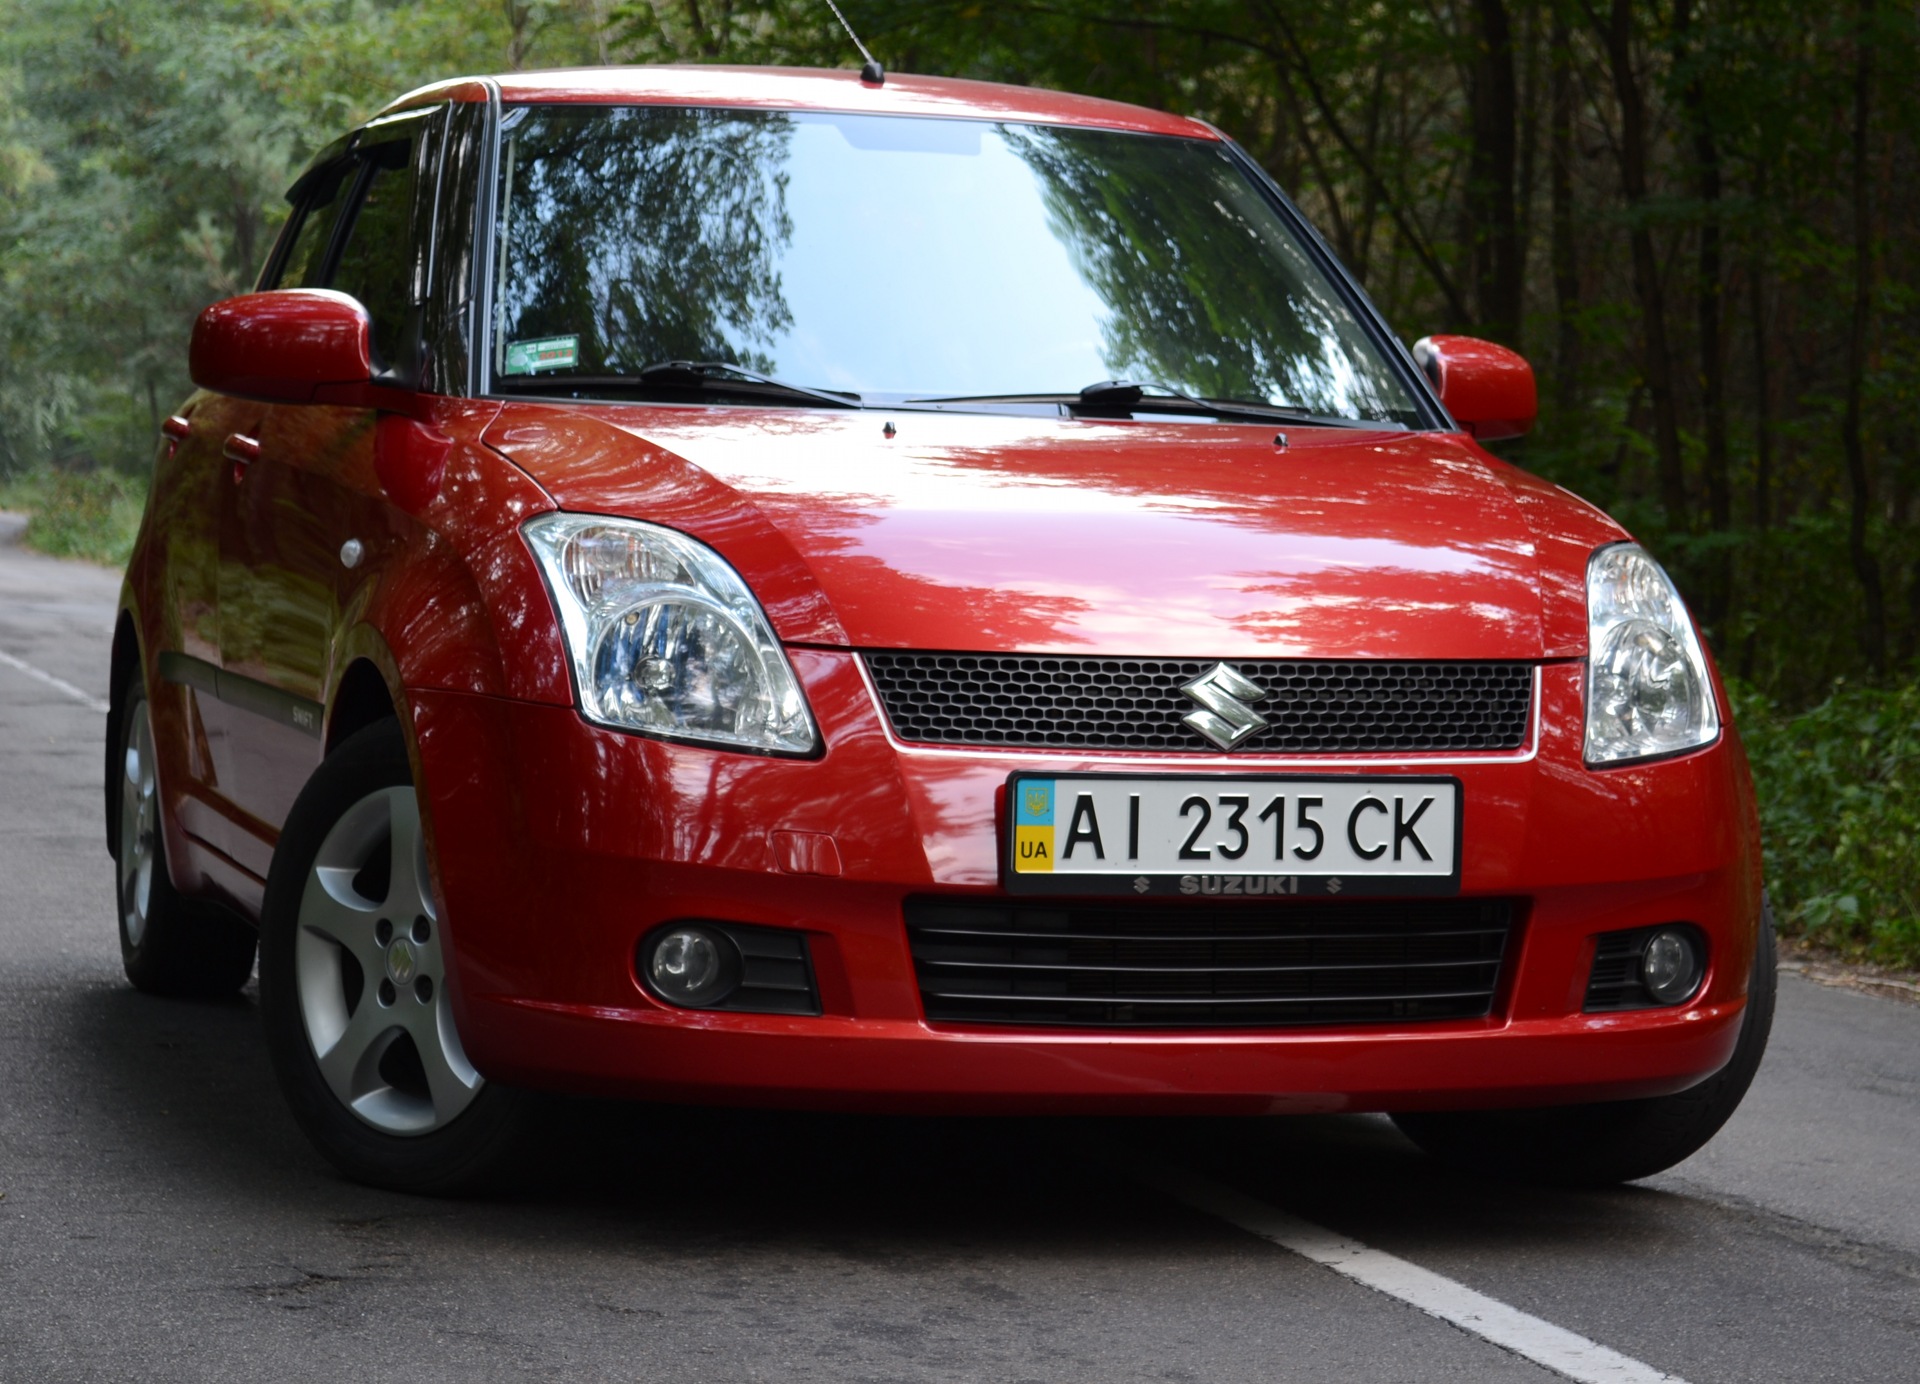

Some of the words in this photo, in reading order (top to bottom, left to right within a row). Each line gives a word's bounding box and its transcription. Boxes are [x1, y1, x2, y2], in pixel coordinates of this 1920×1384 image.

[1178, 795, 1325, 861] 2315
[1347, 797, 1436, 862] CK
[1020, 841, 1048, 859] UA
[1179, 876, 1298, 895] SUZUKI
